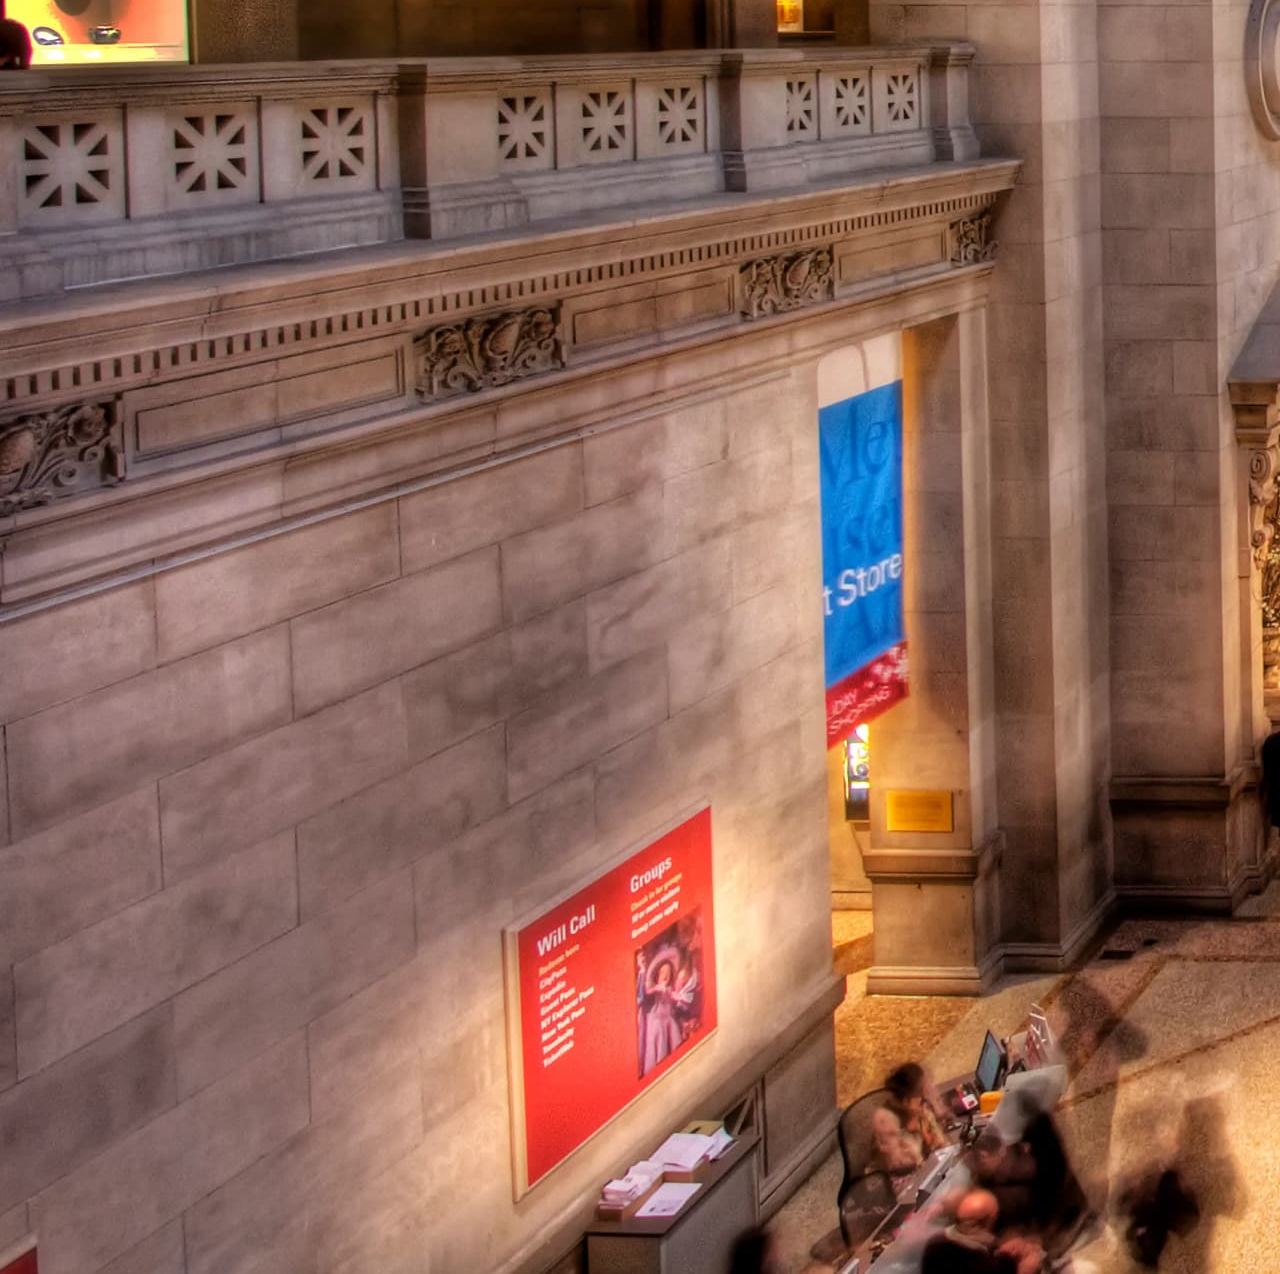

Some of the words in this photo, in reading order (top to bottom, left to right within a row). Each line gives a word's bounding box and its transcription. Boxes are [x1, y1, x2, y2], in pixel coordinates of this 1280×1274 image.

[837, 552, 902, 607] Store
[630, 857, 672, 893] Groups
[537, 924, 566, 957] Will
[569, 904, 595, 935] Call
